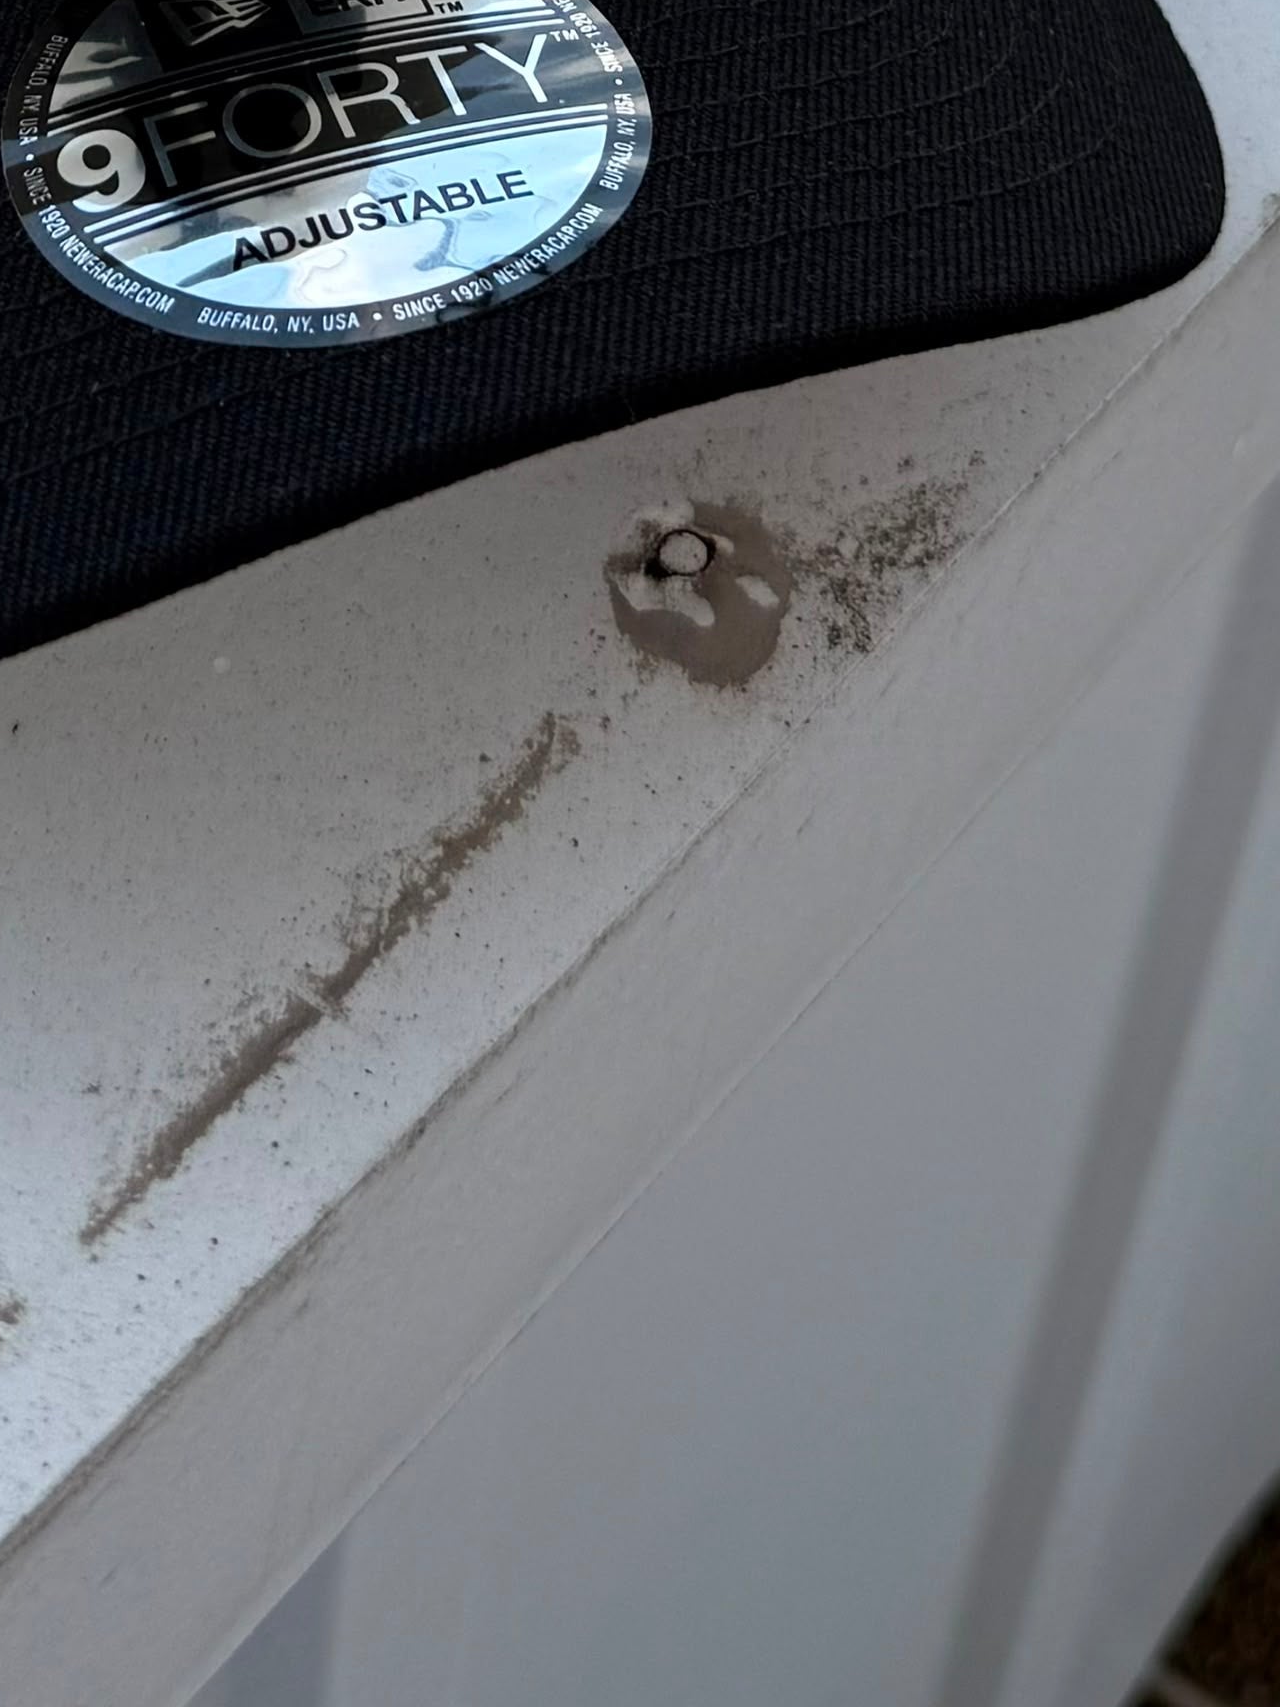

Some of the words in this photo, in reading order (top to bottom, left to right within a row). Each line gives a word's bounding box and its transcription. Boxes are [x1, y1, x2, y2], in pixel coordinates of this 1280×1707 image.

[56, 33, 549, 213] 9FORTY
[232, 169, 535, 271] ADJUSTABLE
[322, 312, 361, 333] USA
[392, 292, 447, 321] SINCE
[450, 277, 494, 304] 1920
[493, 203, 604, 286] NEWERACAP.COM
